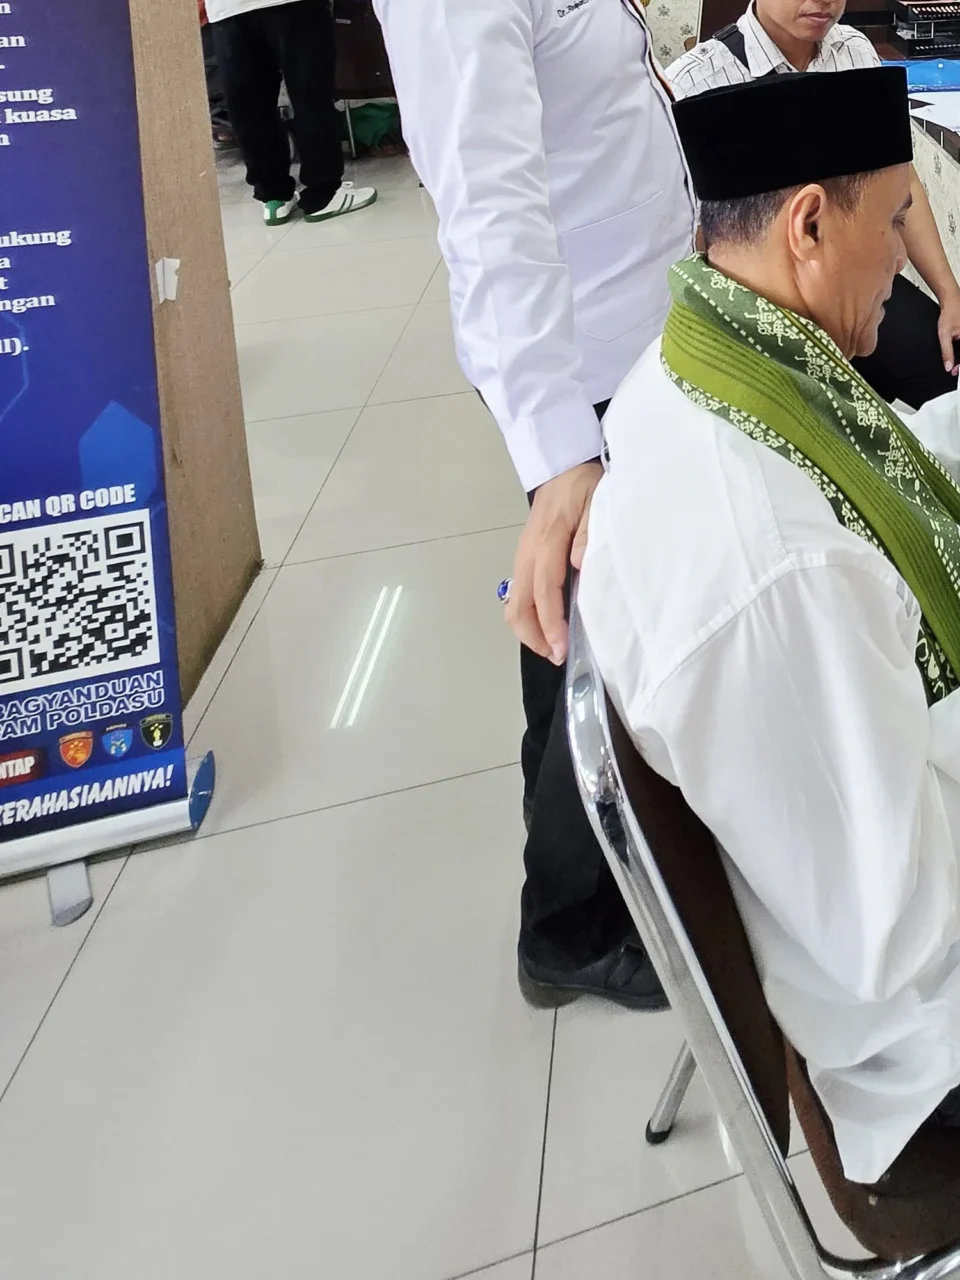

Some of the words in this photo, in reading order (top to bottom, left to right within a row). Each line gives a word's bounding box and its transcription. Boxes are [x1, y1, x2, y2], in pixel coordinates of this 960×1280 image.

[4, 108, 77, 124] kuasa
[45, 493, 75, 517] QR
[79, 483, 136, 510] CODE
[47, 688, 165, 730] POLDASU
